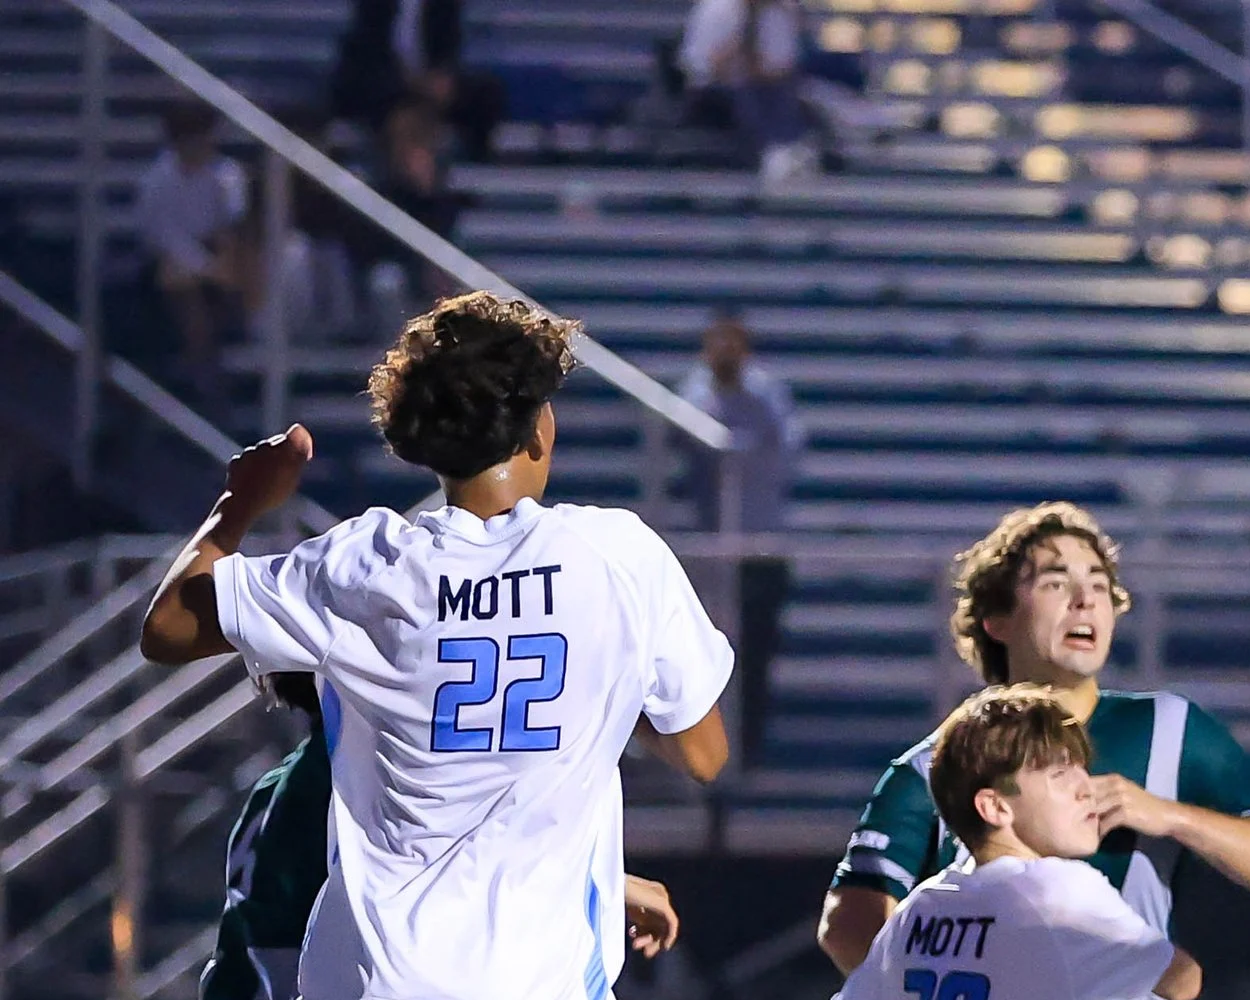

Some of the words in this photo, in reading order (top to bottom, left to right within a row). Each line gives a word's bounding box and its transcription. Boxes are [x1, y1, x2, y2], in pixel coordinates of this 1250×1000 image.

[437, 564, 562, 622] MOTT
[430, 632, 568, 752] 22
[905, 915, 996, 960] MOTT
